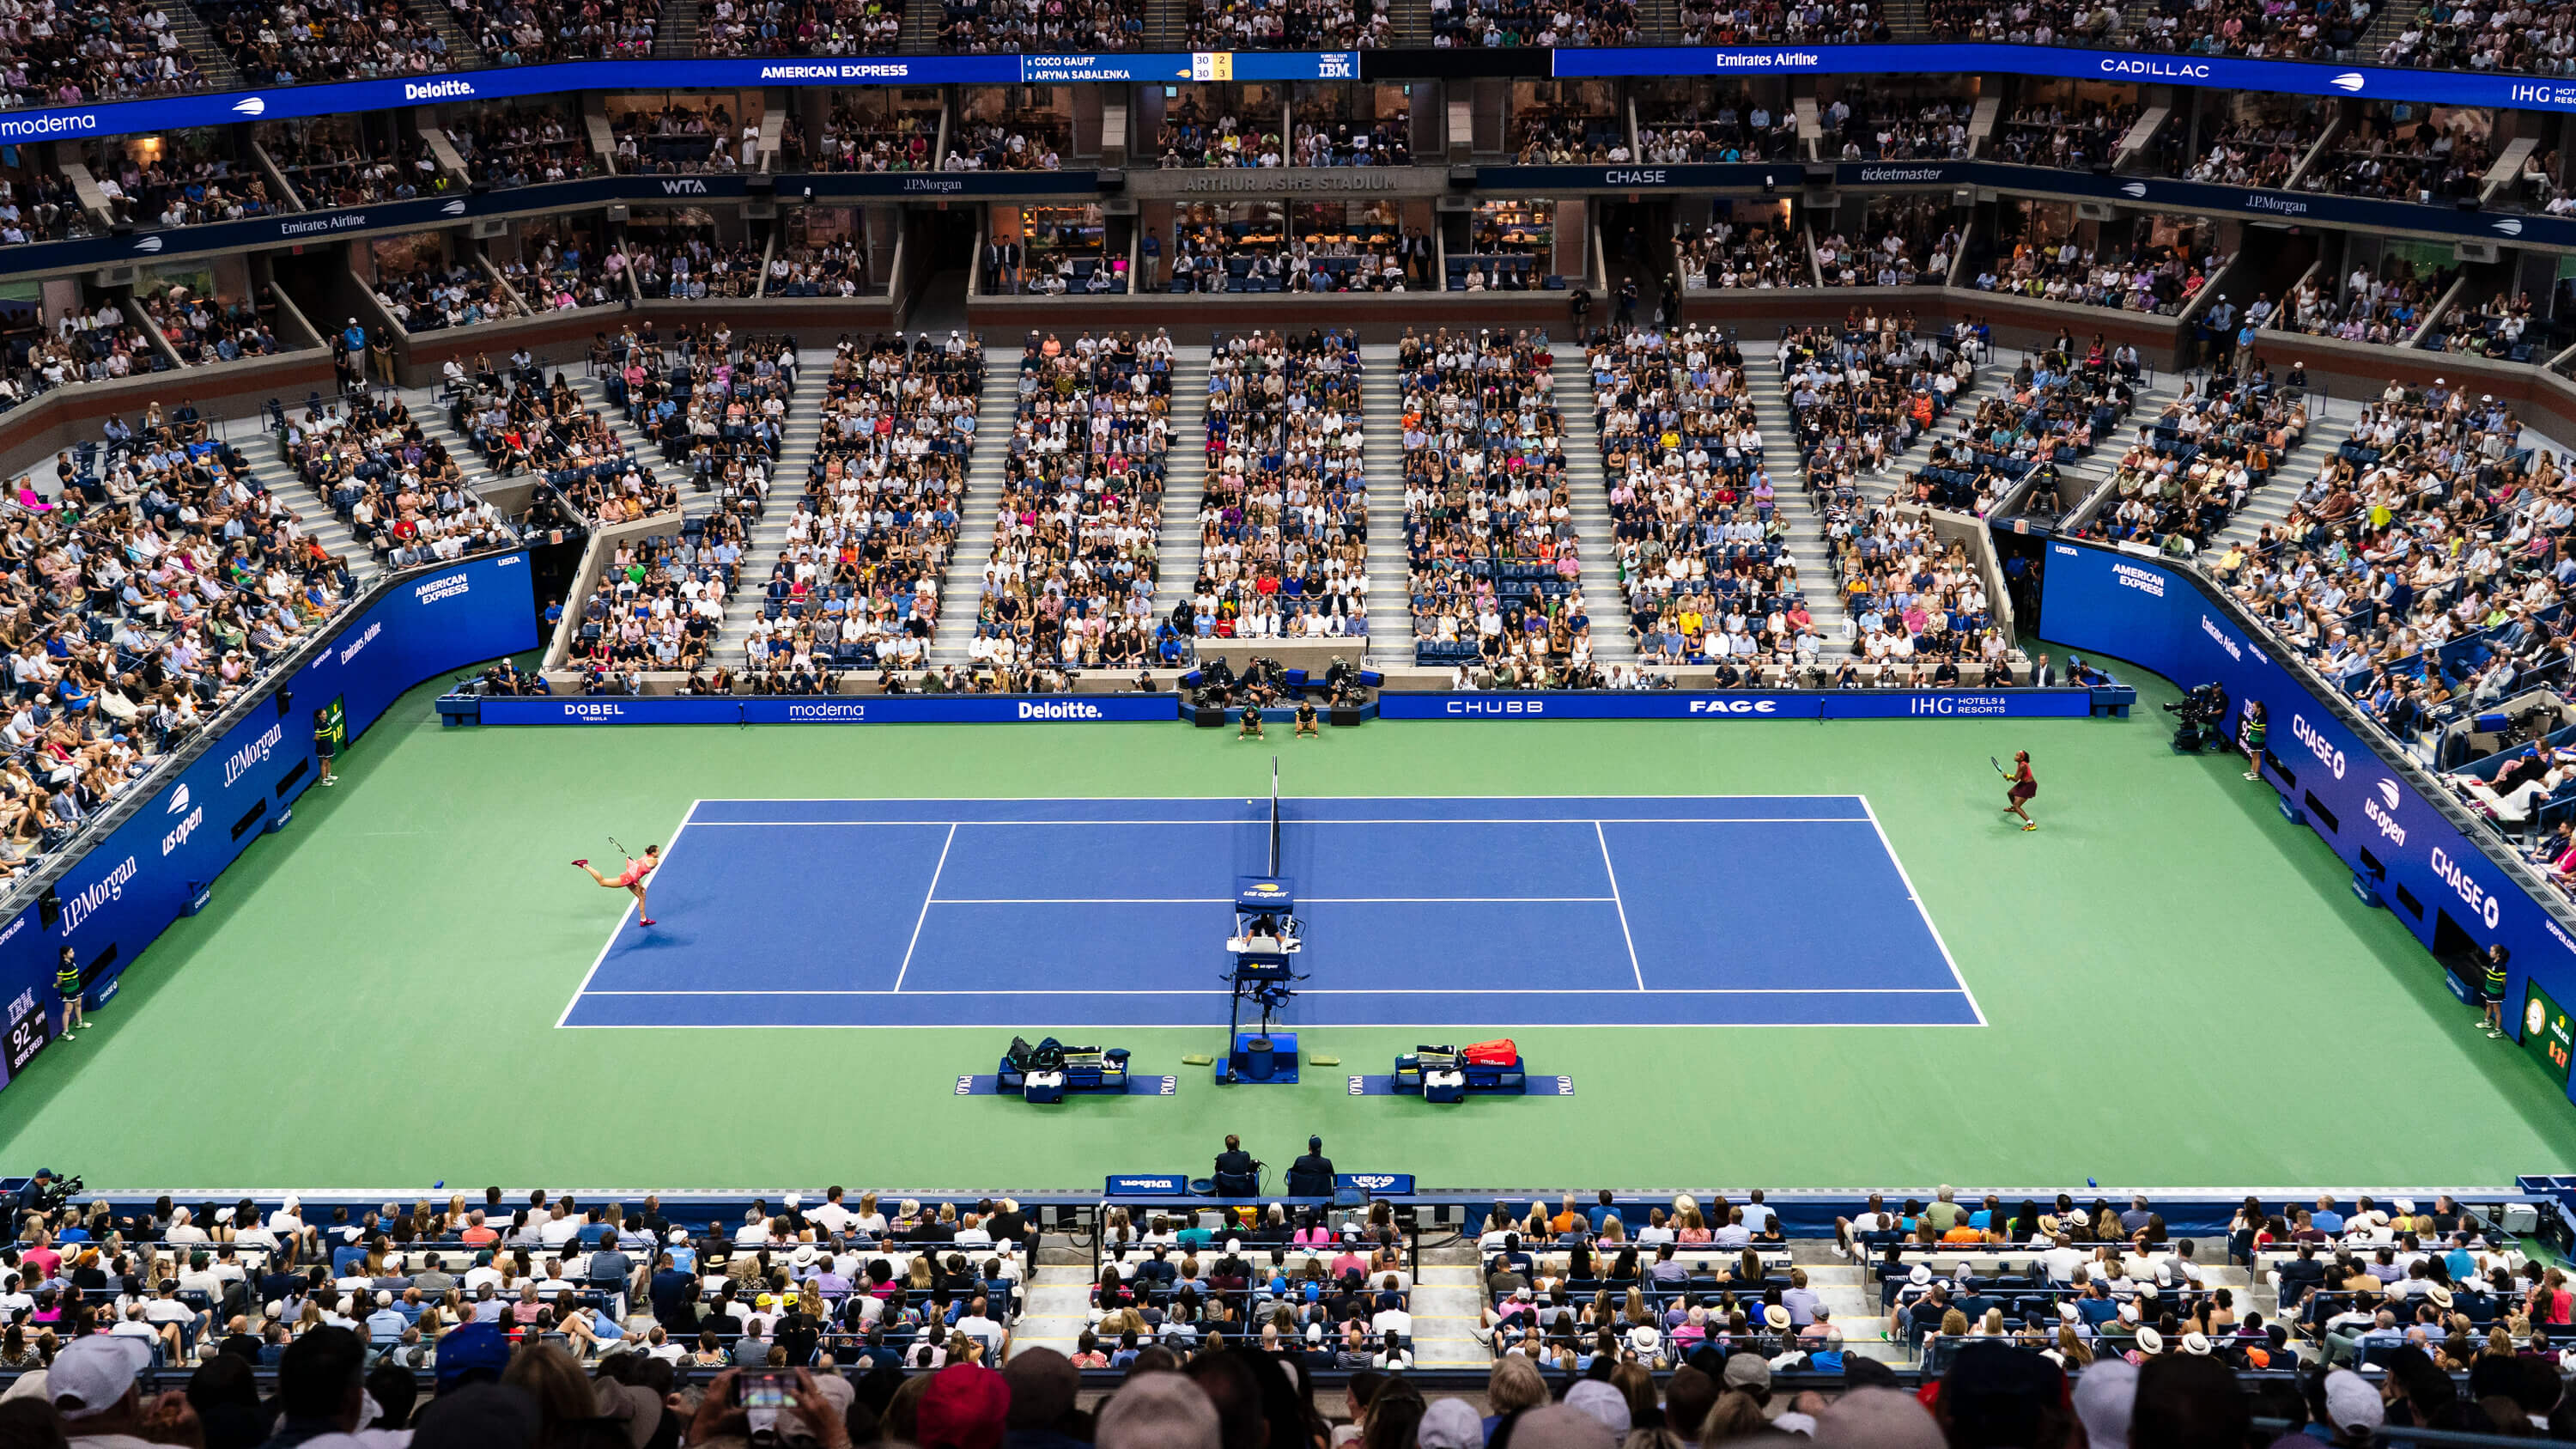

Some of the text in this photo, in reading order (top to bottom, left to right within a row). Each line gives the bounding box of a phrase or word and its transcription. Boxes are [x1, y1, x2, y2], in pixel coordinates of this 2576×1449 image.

[1035, 58, 1060, 66] COCO
[1063, 57, 1095, 66] GAUFF
[1196, 56, 1209, 64] 30
[1716, 53, 1818, 68] Emirates Airline
[2100, 59, 2209, 78] CADILLAC
[761, 64, 908, 78] AMERICAN EXPRESS
[1035, 70, 1071, 80] ARYNA
[1072, 70, 1130, 79] SABALENKA
[1319, 64, 1351, 76] IBM
[405, 80, 475, 100] Deloitte.
[2512, 84, 2550, 102] IHG
[1, 114, 96, 137] moderna
[1184, 175, 1398, 192] ARTHUR ASHE STADIUM
[1606, 170, 1666, 183] CHASE
[1861, 167, 1942, 181] ticketmaster
[662, 180, 708, 194] WTA
[282, 215, 366, 234] Emirates Airline
[2055, 545, 2078, 557] USTA
[498, 557, 520, 566] USTA
[2111, 563, 2165, 588] AMERICAN
[415, 573, 468, 598] AMERICAN
[422, 583, 470, 605] EXPRESS
[2119, 575, 2164, 597] EXPRESS
[341, 622, 381, 665] Emirates Airline
[2202, 614, 2241, 662] Emirates Airline
[564, 704, 625, 715] DOBEL
[789, 703, 865, 716] moderna
[1018, 701, 1102, 719] Deloitte.
[1447, 702, 1544, 713] CHUBB
[1689, 701, 1776, 713] FAGE
[1911, 697, 1954, 714] IHG
[2292, 715, 2336, 769] CHASE
[224, 723, 283, 788] J.P.Morgan
[162, 805, 204, 857] us open
[2365, 797, 2406, 847] us open
[2431, 846, 2485, 916] CHASE
[61, 855, 137, 937] J.P.Morgan
[1258, 891, 1288, 899] open
[8, 986, 36, 1026] IBM
[13, 1022, 32, 1052] 92
[955, 1075, 975, 1096] POLO
[1160, 1075, 1177, 1096] POLO
[1349, 1075, 1364, 1096] POLO
[1556, 1075, 1575, 1096] POLO
